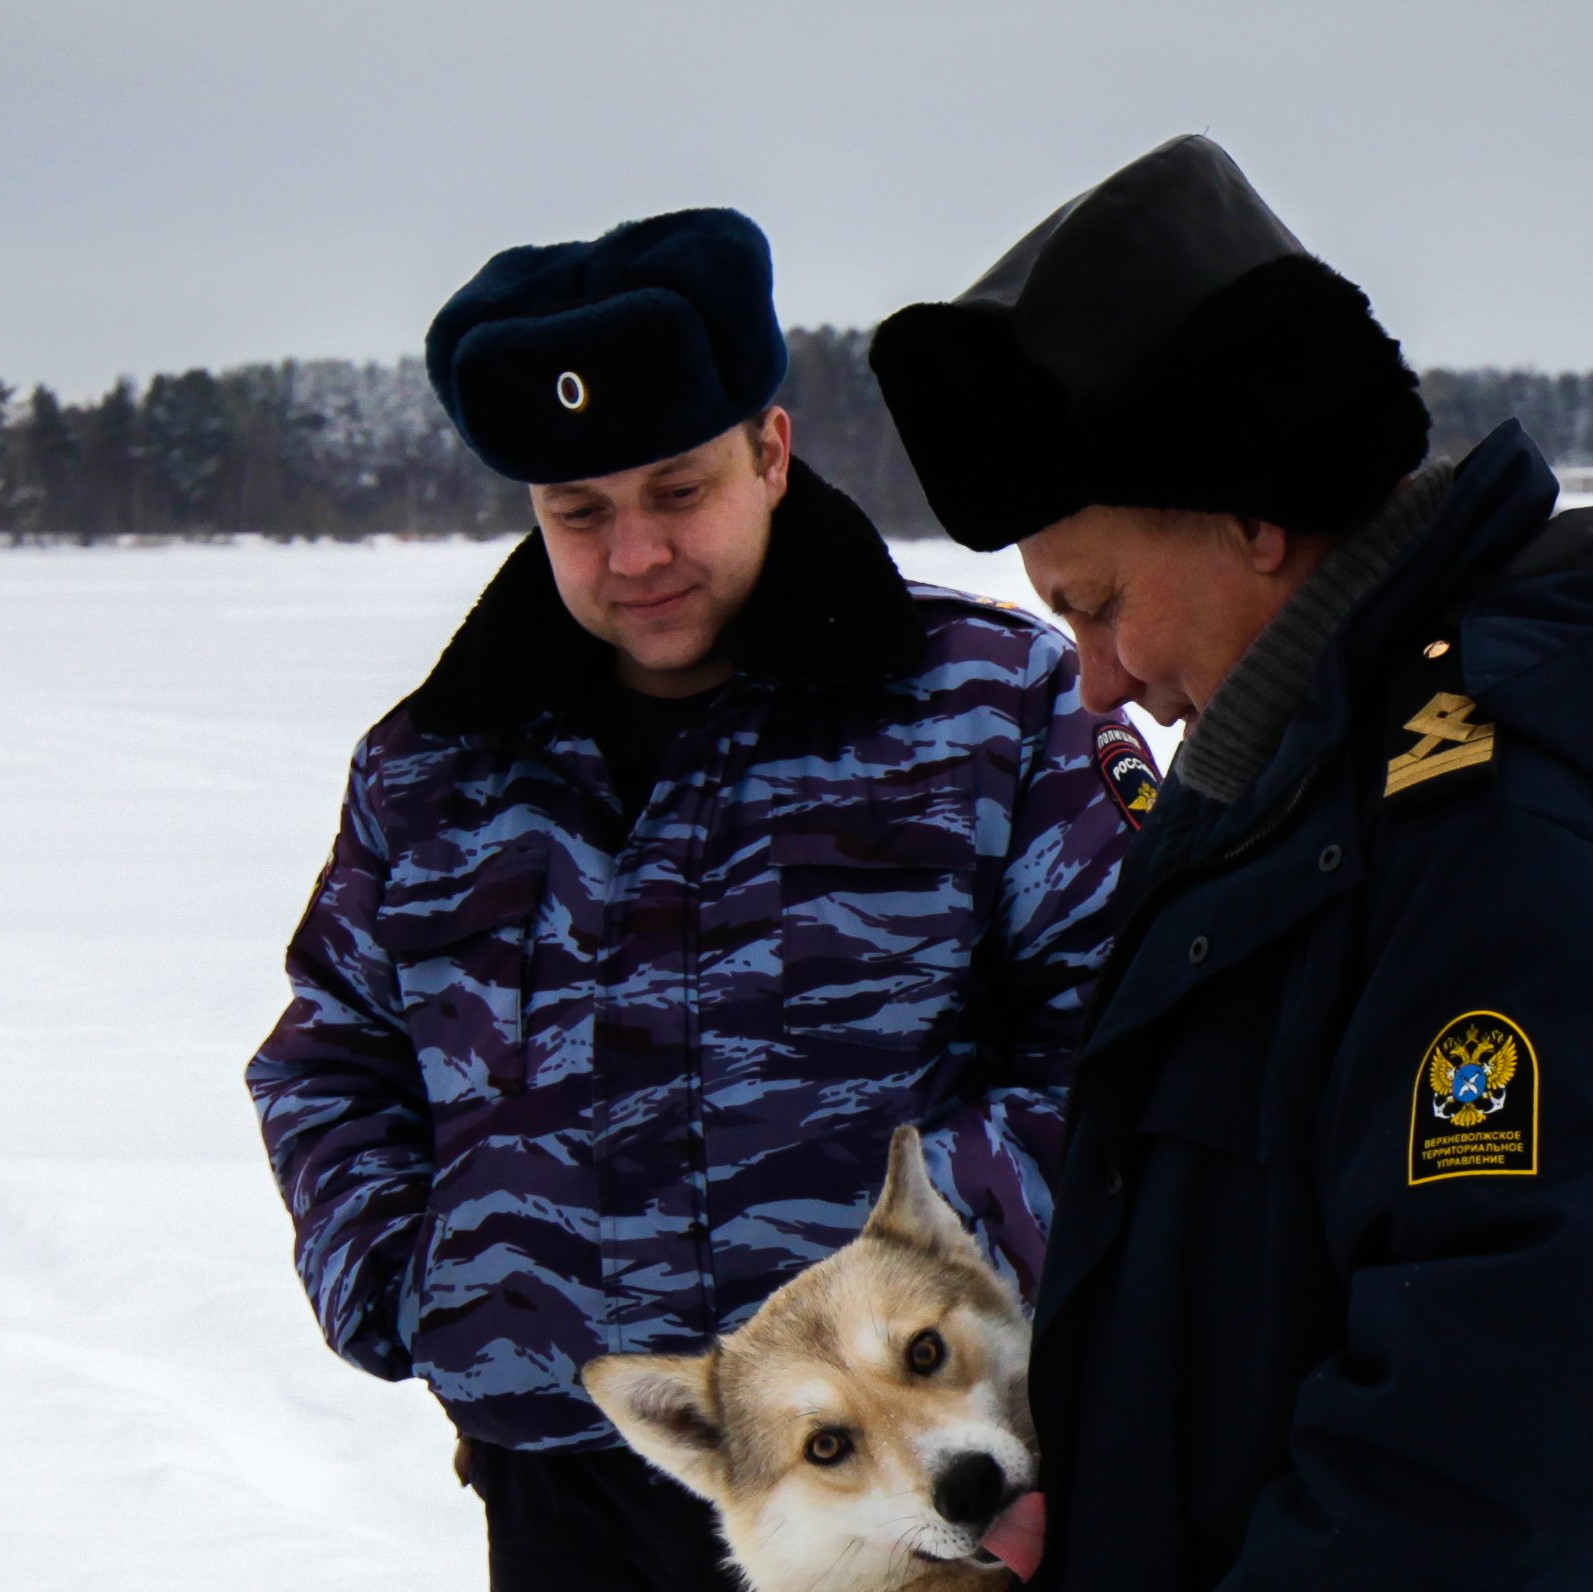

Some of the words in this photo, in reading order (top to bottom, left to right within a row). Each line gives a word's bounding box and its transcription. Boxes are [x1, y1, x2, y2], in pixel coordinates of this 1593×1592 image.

[1112, 757, 1158, 782] РОСС
[1424, 1131, 1521, 1148] ВЕРХНЕВОЛЖСКОЕ
[1422, 1143, 1525, 1160] ТЕРРИТОРИАЛЬНОЕ
[1437, 1155, 1505, 1169] УПРАВЛЕНИЕ
